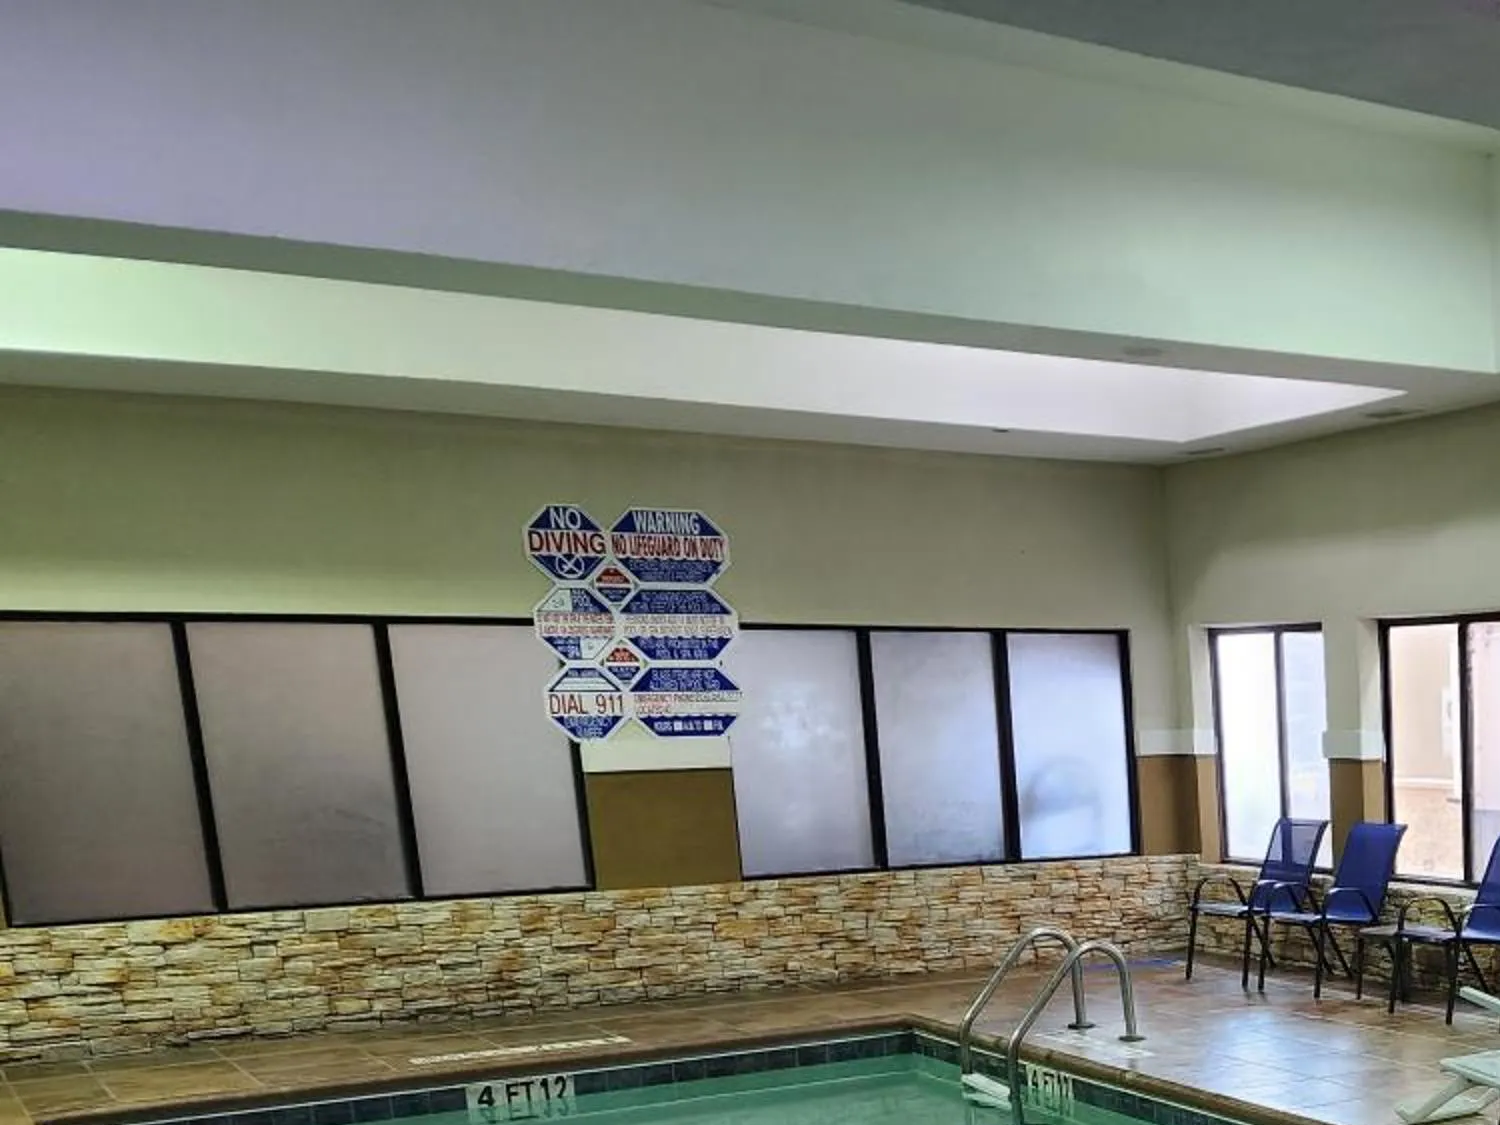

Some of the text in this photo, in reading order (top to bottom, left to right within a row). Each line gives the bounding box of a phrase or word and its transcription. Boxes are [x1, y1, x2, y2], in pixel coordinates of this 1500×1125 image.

[549, 507, 581, 529] NO
[632, 511, 701, 535] WARNING
[529, 531, 606, 554] DIVING
[611, 534, 725, 560] NO LIFEGUARD ON DUTY
[549, 694, 589, 715] DIAL
[595, 694, 623, 714] 911
[478, 1085, 495, 1106] 4
[506, 1081, 534, 1104] FT
